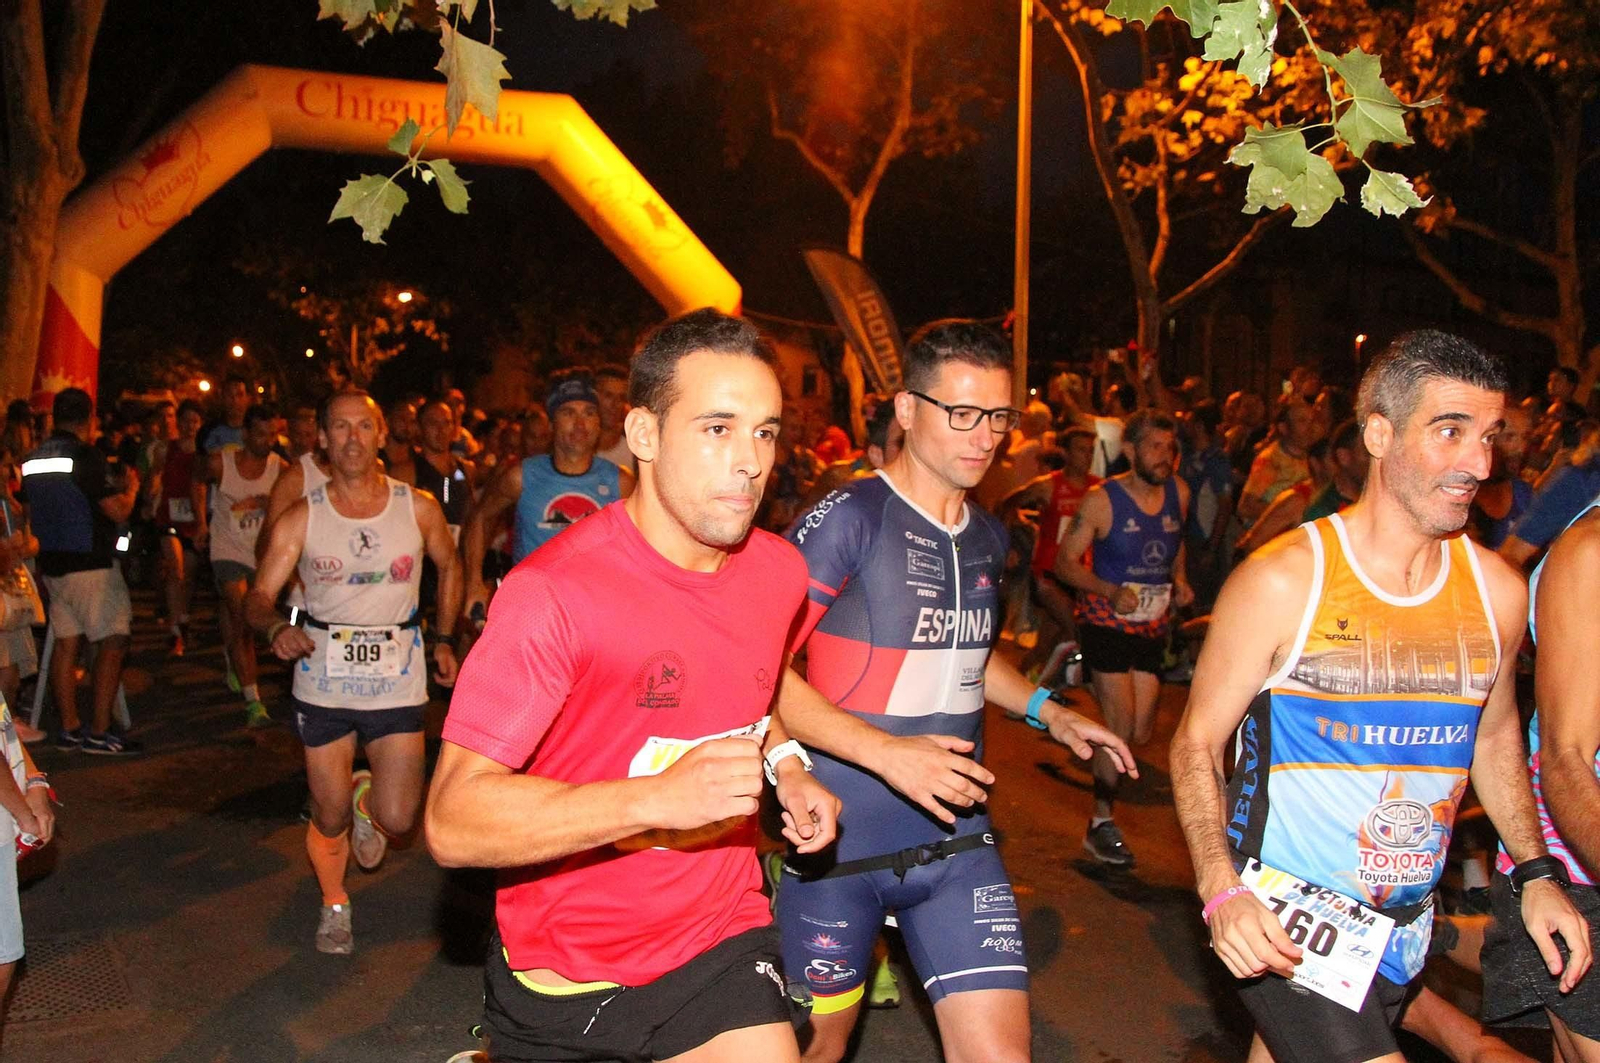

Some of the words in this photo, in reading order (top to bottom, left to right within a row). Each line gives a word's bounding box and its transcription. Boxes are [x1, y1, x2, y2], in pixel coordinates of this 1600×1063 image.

[315, 560, 337, 570] KIA
[916, 588, 938, 598] IVECO
[911, 605, 993, 644] ESPINA
[1324, 632, 1363, 642] SPALL
[343, 643, 381, 662] 309
[1361, 723, 1470, 746] HUELVA
[1359, 850, 1435, 870] TOYOTA
[1357, 868, 1398, 885] Toyota
[1399, 871, 1432, 885] Huelva
[1282, 890, 1310, 907] DE
[1307, 897, 1371, 939] HUELVA
[991, 924, 1018, 933] IVECO
